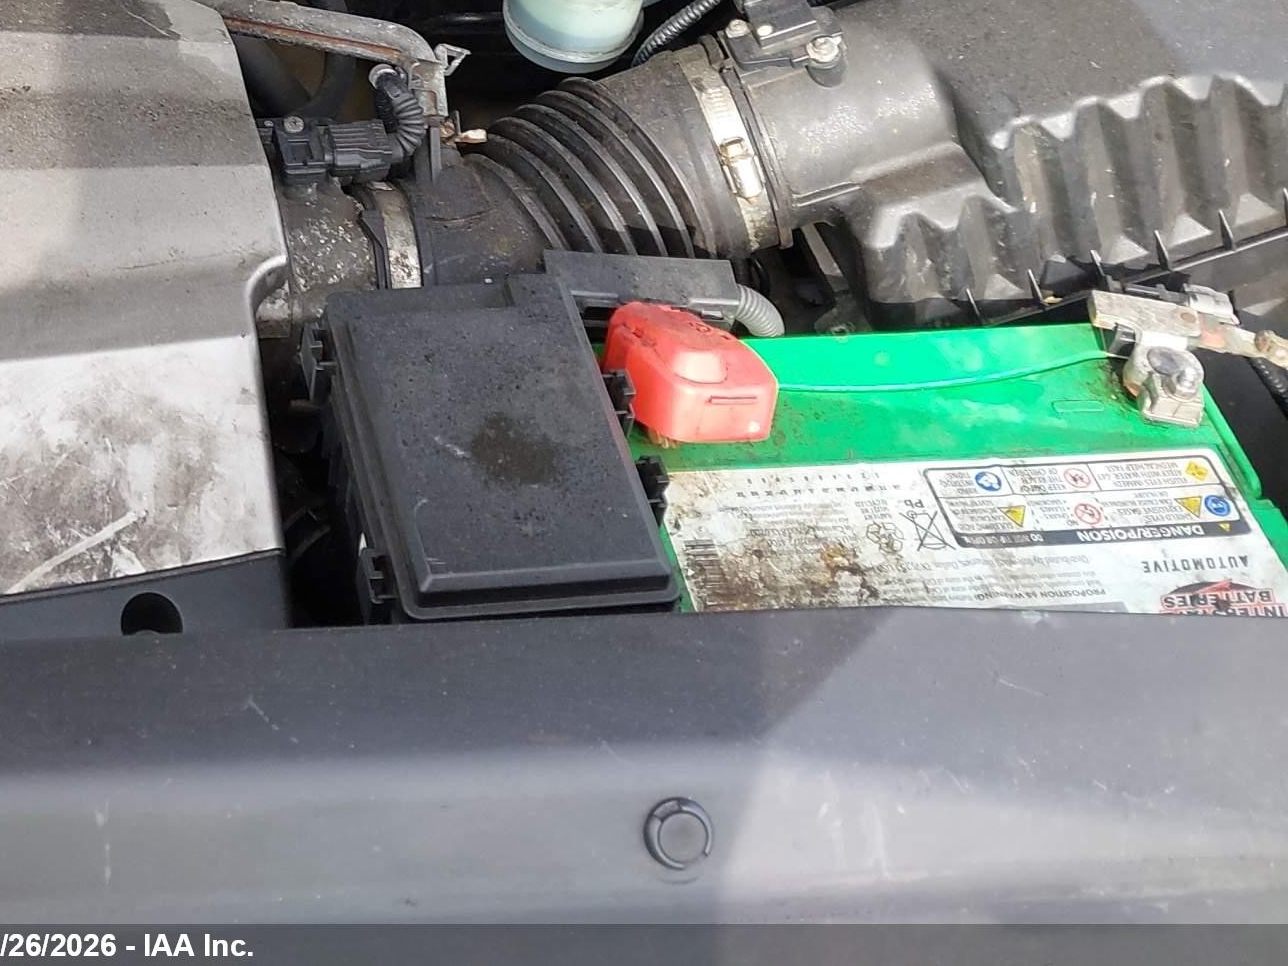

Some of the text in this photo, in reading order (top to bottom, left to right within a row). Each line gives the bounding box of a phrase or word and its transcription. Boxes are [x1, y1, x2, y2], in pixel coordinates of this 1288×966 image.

[903, 499, 924, 508] Pb
[1076, 525, 1205, 541] DANGER/POISON
[1141, 555, 1248, 573] AUTOMOTIVE
[1039, 588, 1106, 598] PROPOSITION
[1164, 591, 1271, 608] BATTERIES
